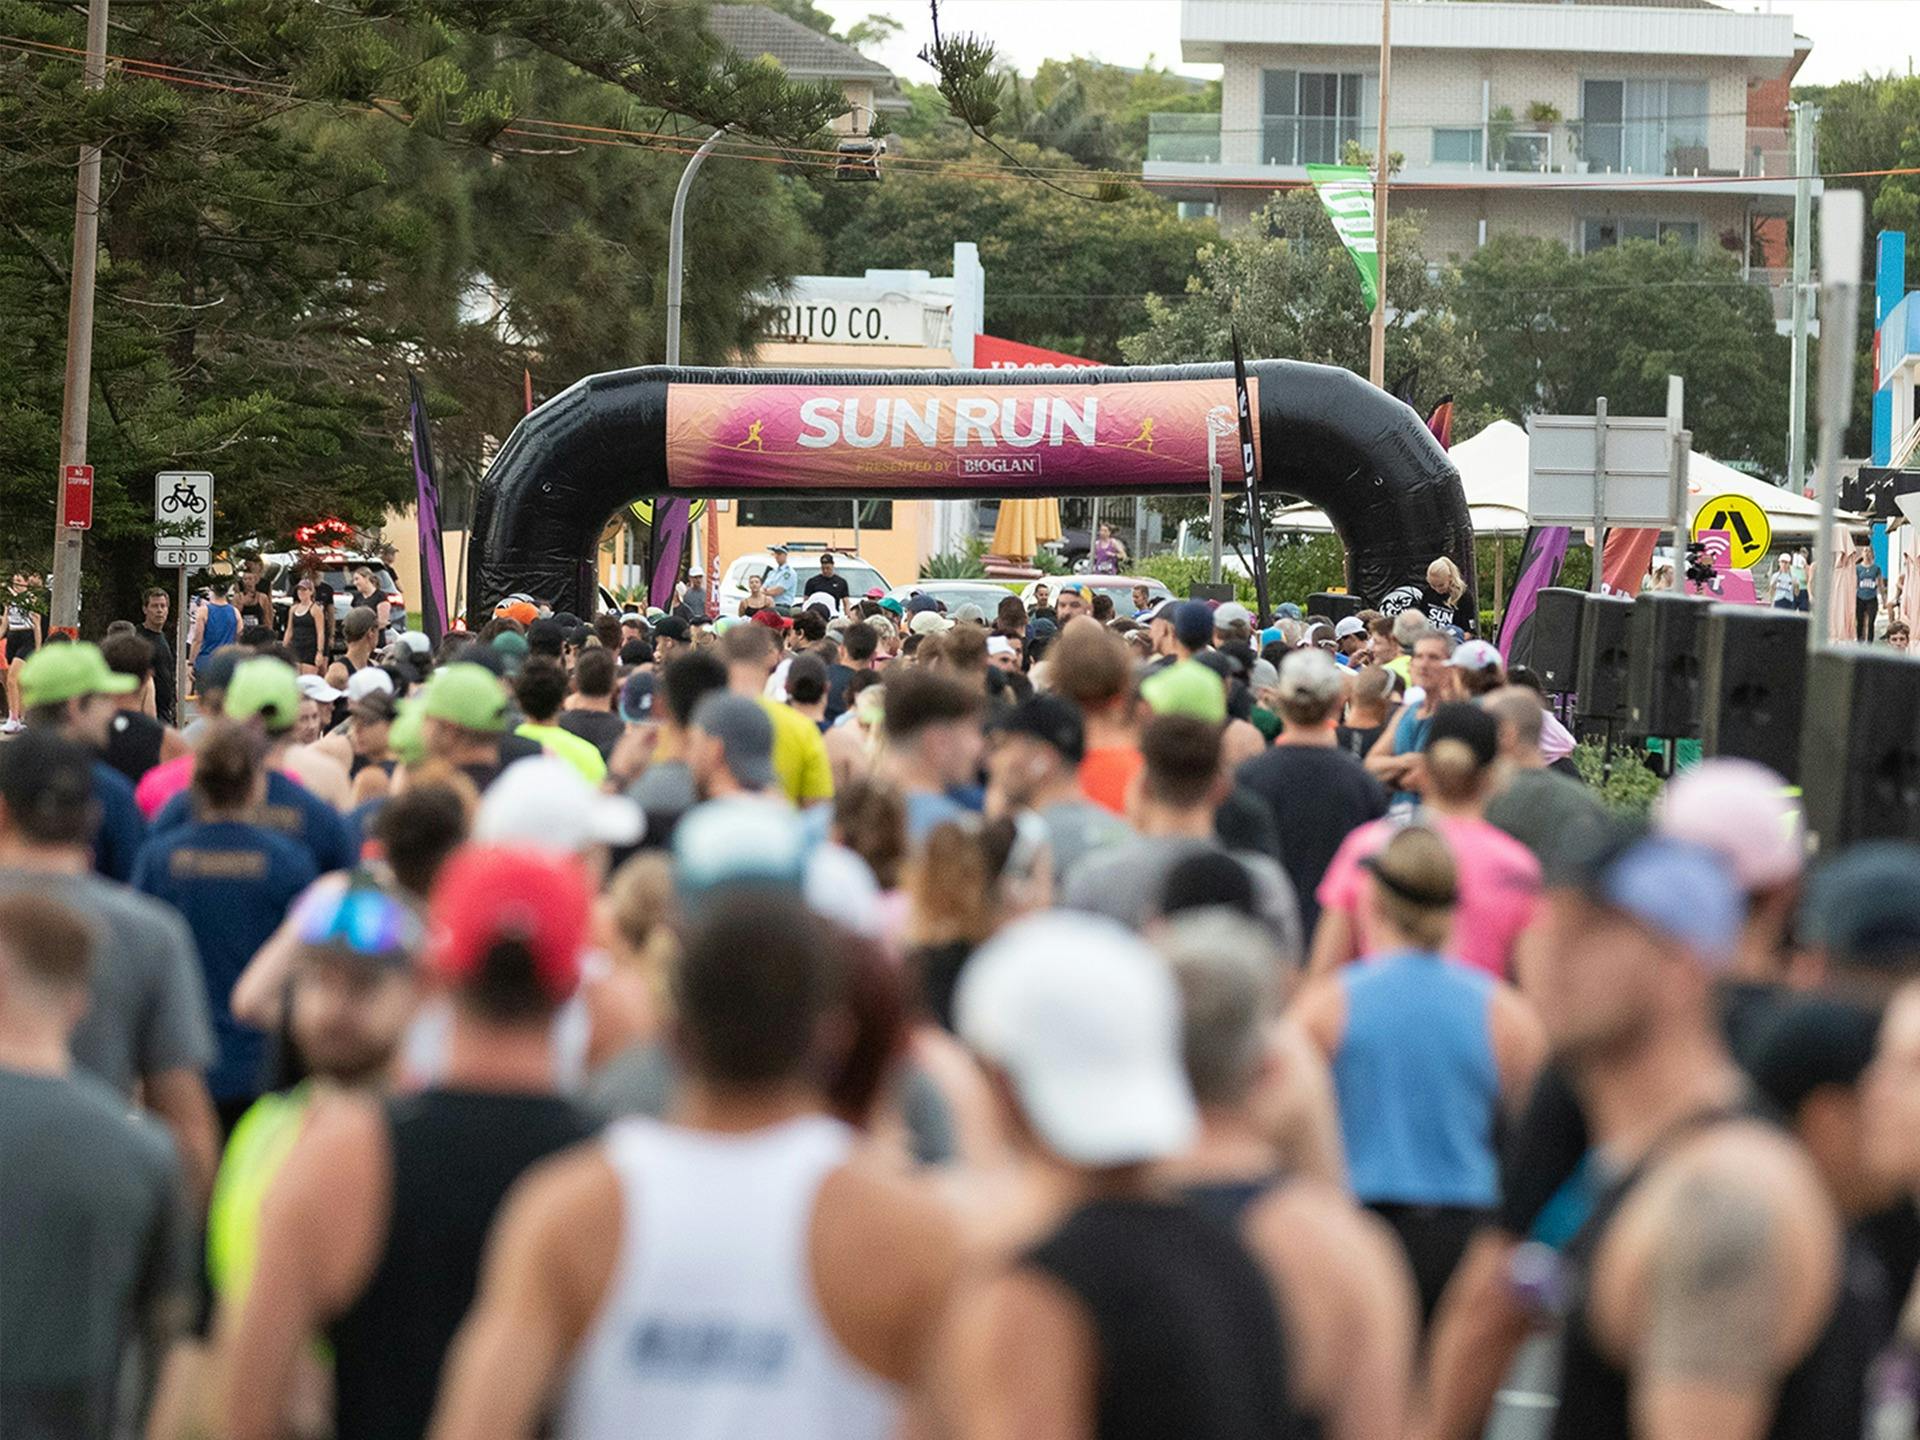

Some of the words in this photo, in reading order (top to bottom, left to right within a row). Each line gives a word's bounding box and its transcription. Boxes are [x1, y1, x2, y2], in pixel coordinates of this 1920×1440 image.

[848, 307, 889, 340] CO.
[797, 396, 940, 448] SUN
[953, 396, 1098, 448] RUN
[857, 461, 932, 473] PRESENTED
[934, 462, 951, 473] BY
[964, 458, 1036, 473] BIOGLAN
[168, 552, 198, 563] END
[1428, 608, 1454, 625] SUN
